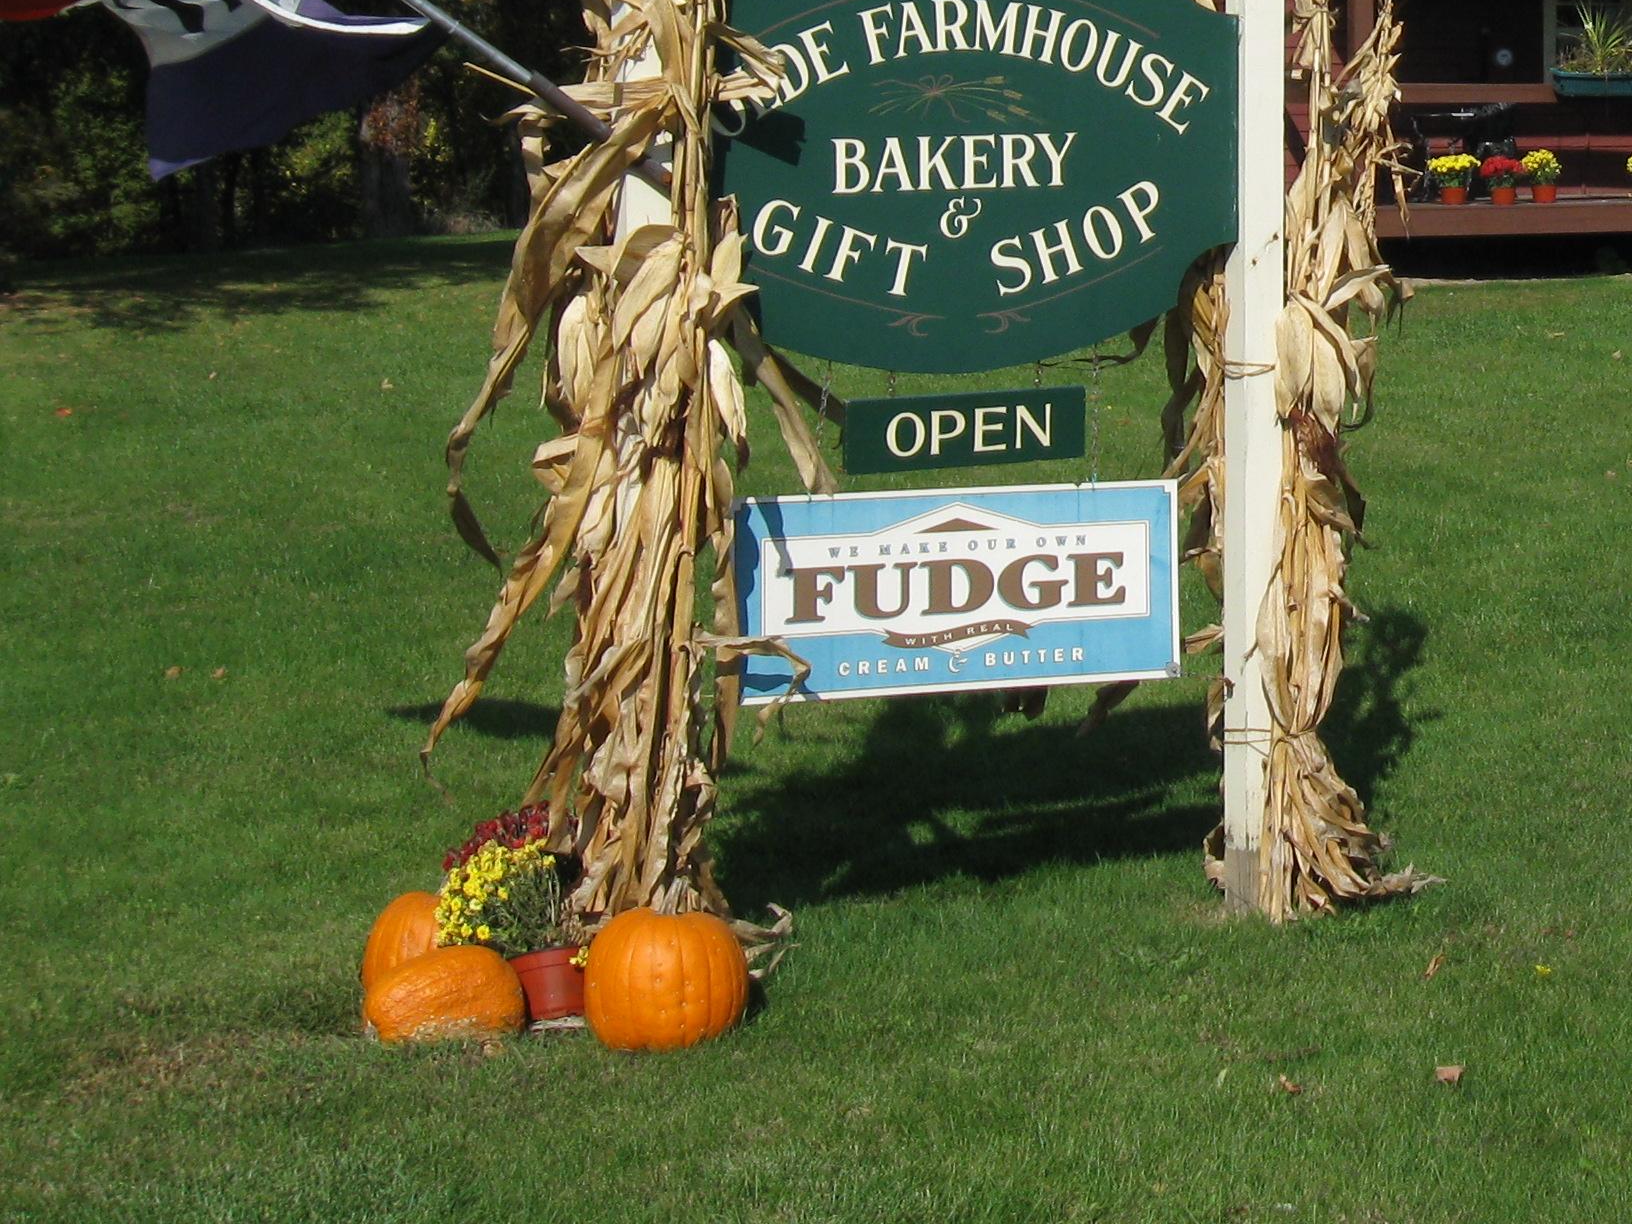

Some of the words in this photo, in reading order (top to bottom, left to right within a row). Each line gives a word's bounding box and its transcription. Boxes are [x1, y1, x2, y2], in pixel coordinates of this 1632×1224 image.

[831, 132, 1077, 194] BAKERY
[753, 199, 928, 296] GIFT
[990, 180, 1161, 297] SHOP
[939, 196, 982, 239] &
[886, 403, 1052, 457] OPEN
[828, 546, 860, 559] WE
[879, 541, 948, 556] MAKE
[967, 537, 1016, 552] OUR
[1036, 534, 1088, 549] OWN
[785, 551, 1126, 625] FUDGE
[904, 631, 954, 647] WITH
[966, 623, 1014, 636] REAL
[838, 656, 930, 676] CREAM
[985, 646, 1085, 667] BUTTER
